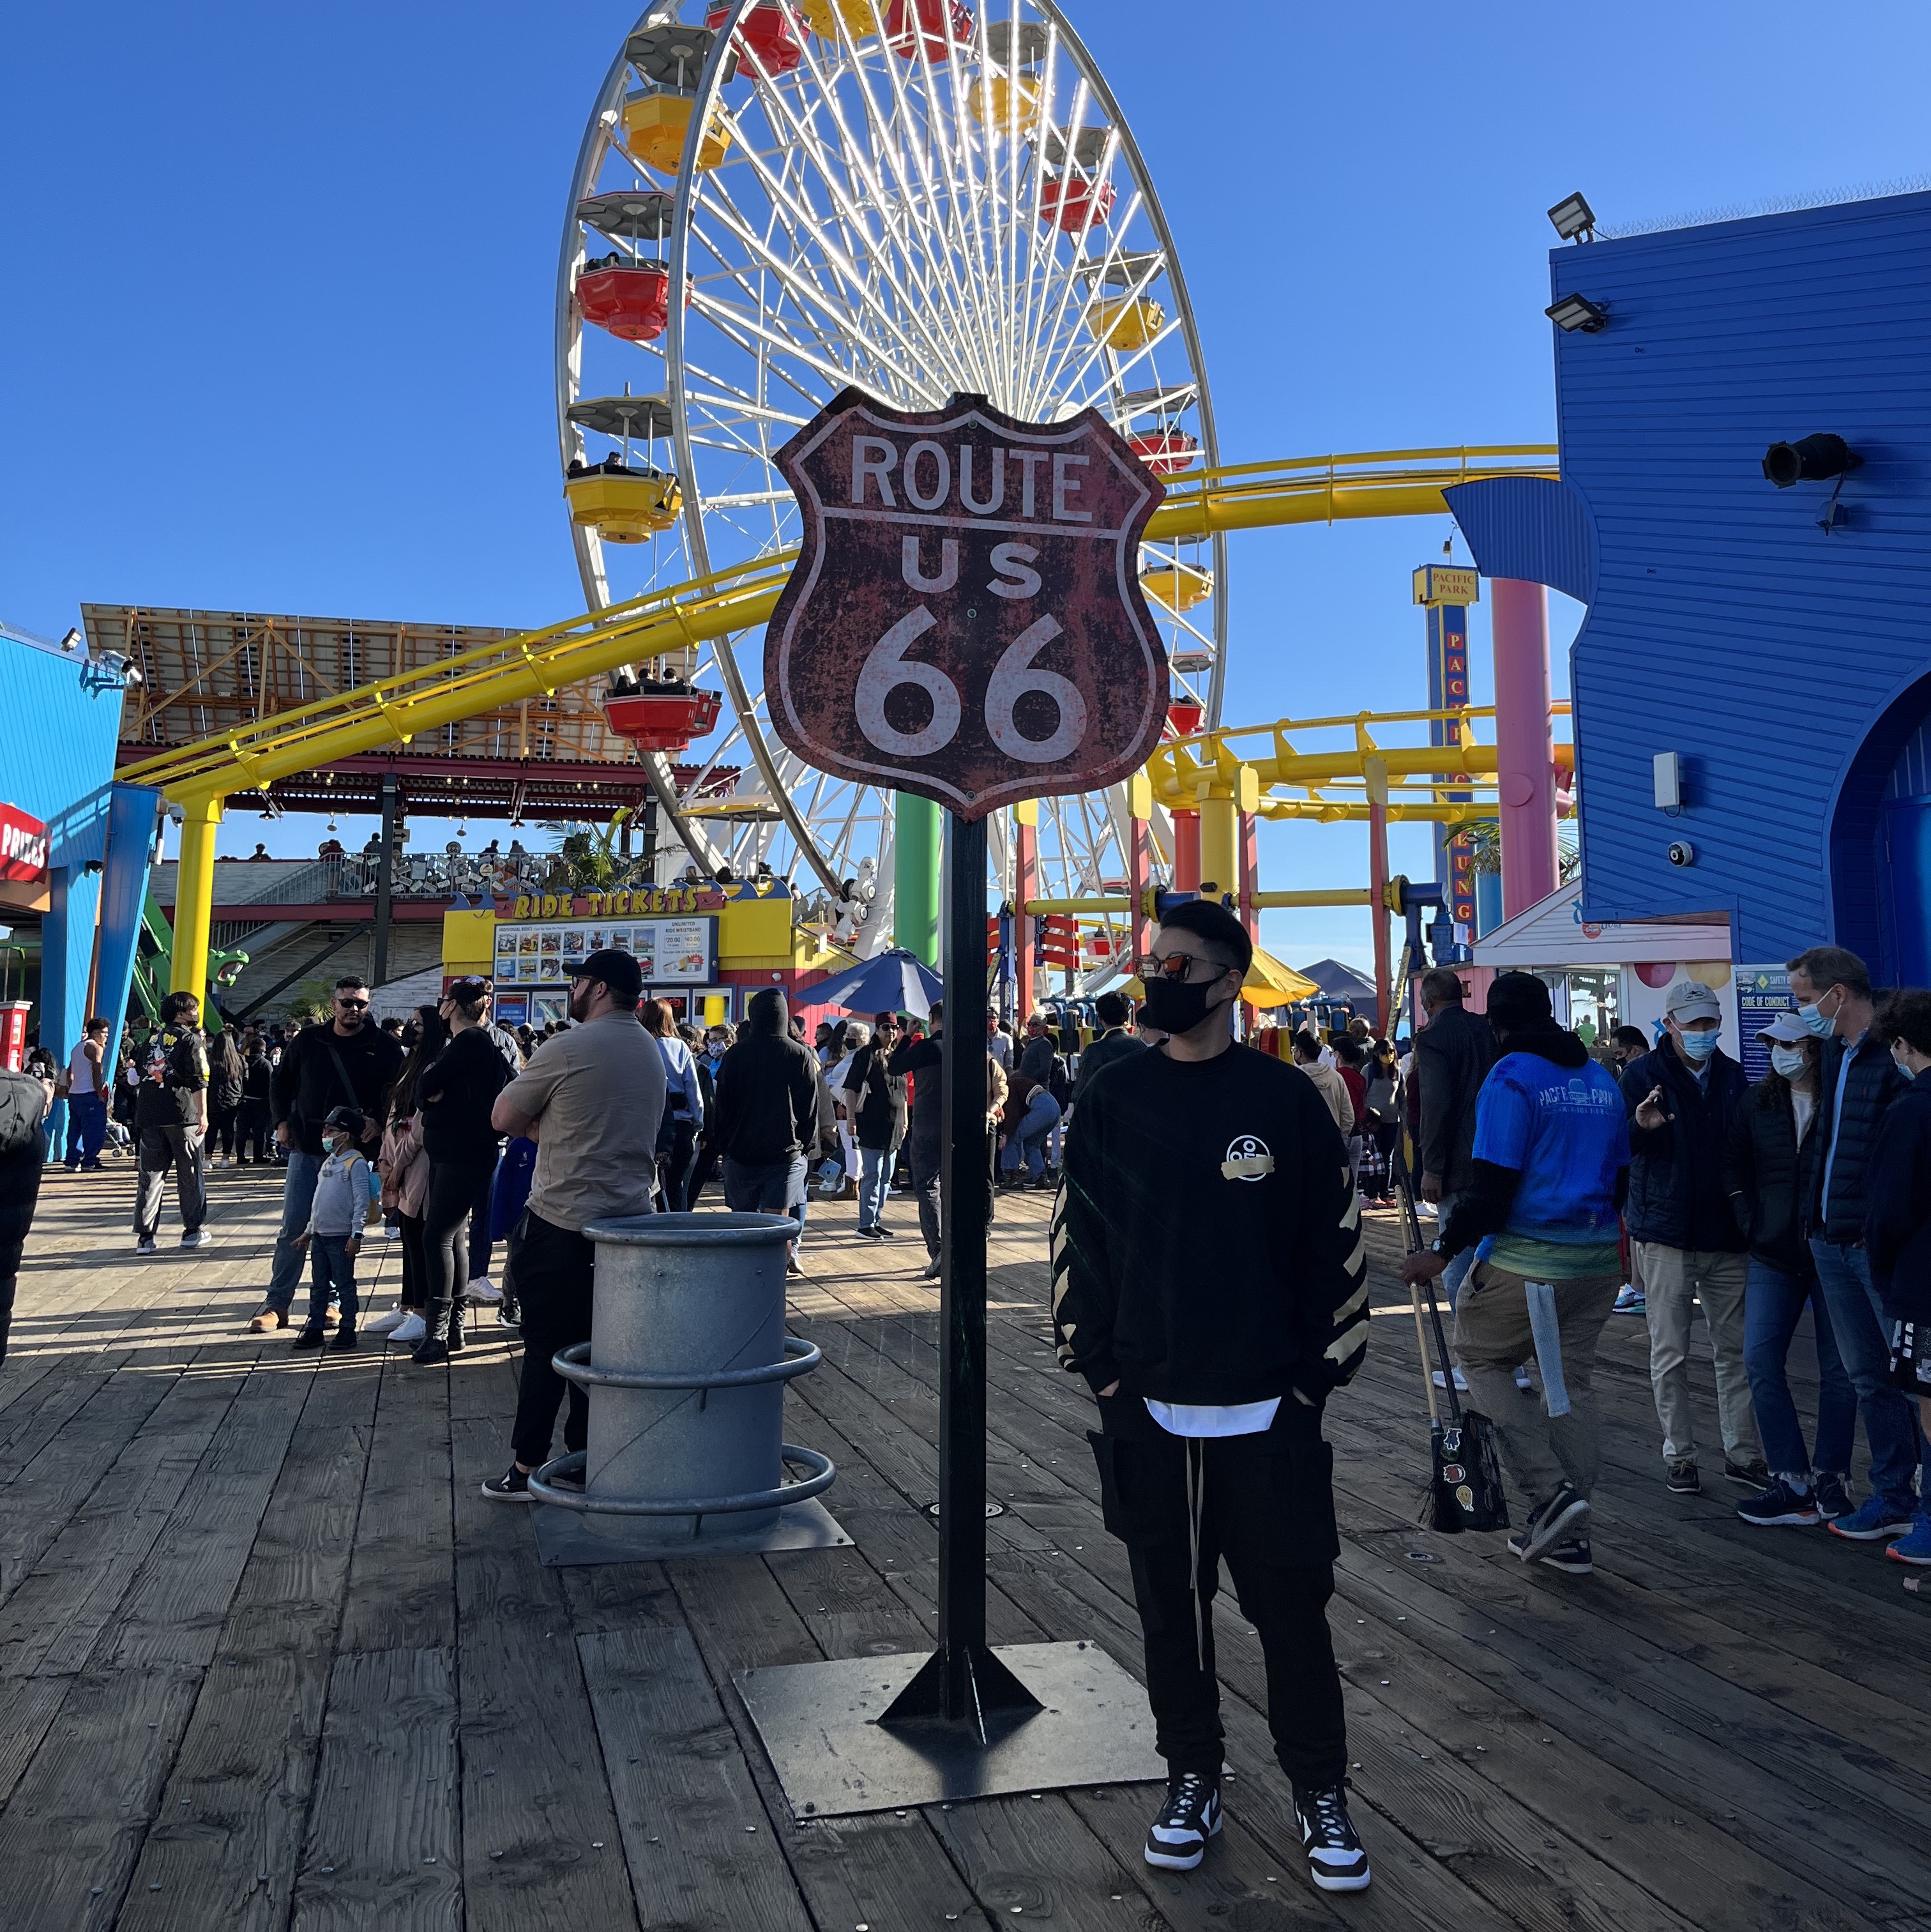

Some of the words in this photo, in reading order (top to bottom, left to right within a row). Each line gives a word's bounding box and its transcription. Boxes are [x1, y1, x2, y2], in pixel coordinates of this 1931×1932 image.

[851, 434, 1093, 522] ROUTE
[1433, 573, 1474, 584] PACIFIC
[1440, 584, 1468, 594] PARK
[854, 604, 1086, 763] 66
[1, 823, 46, 869] PRIZES
[512, 894, 574, 918] RIDE
[587, 887, 699, 917] TICKETS
[1769, 975, 1786, 985] SAFETY
[1741, 996, 1755, 1007] CODE
[1756, 996, 1764, 1007] OF
[1765, 996, 1790, 1007] CONDUCT
